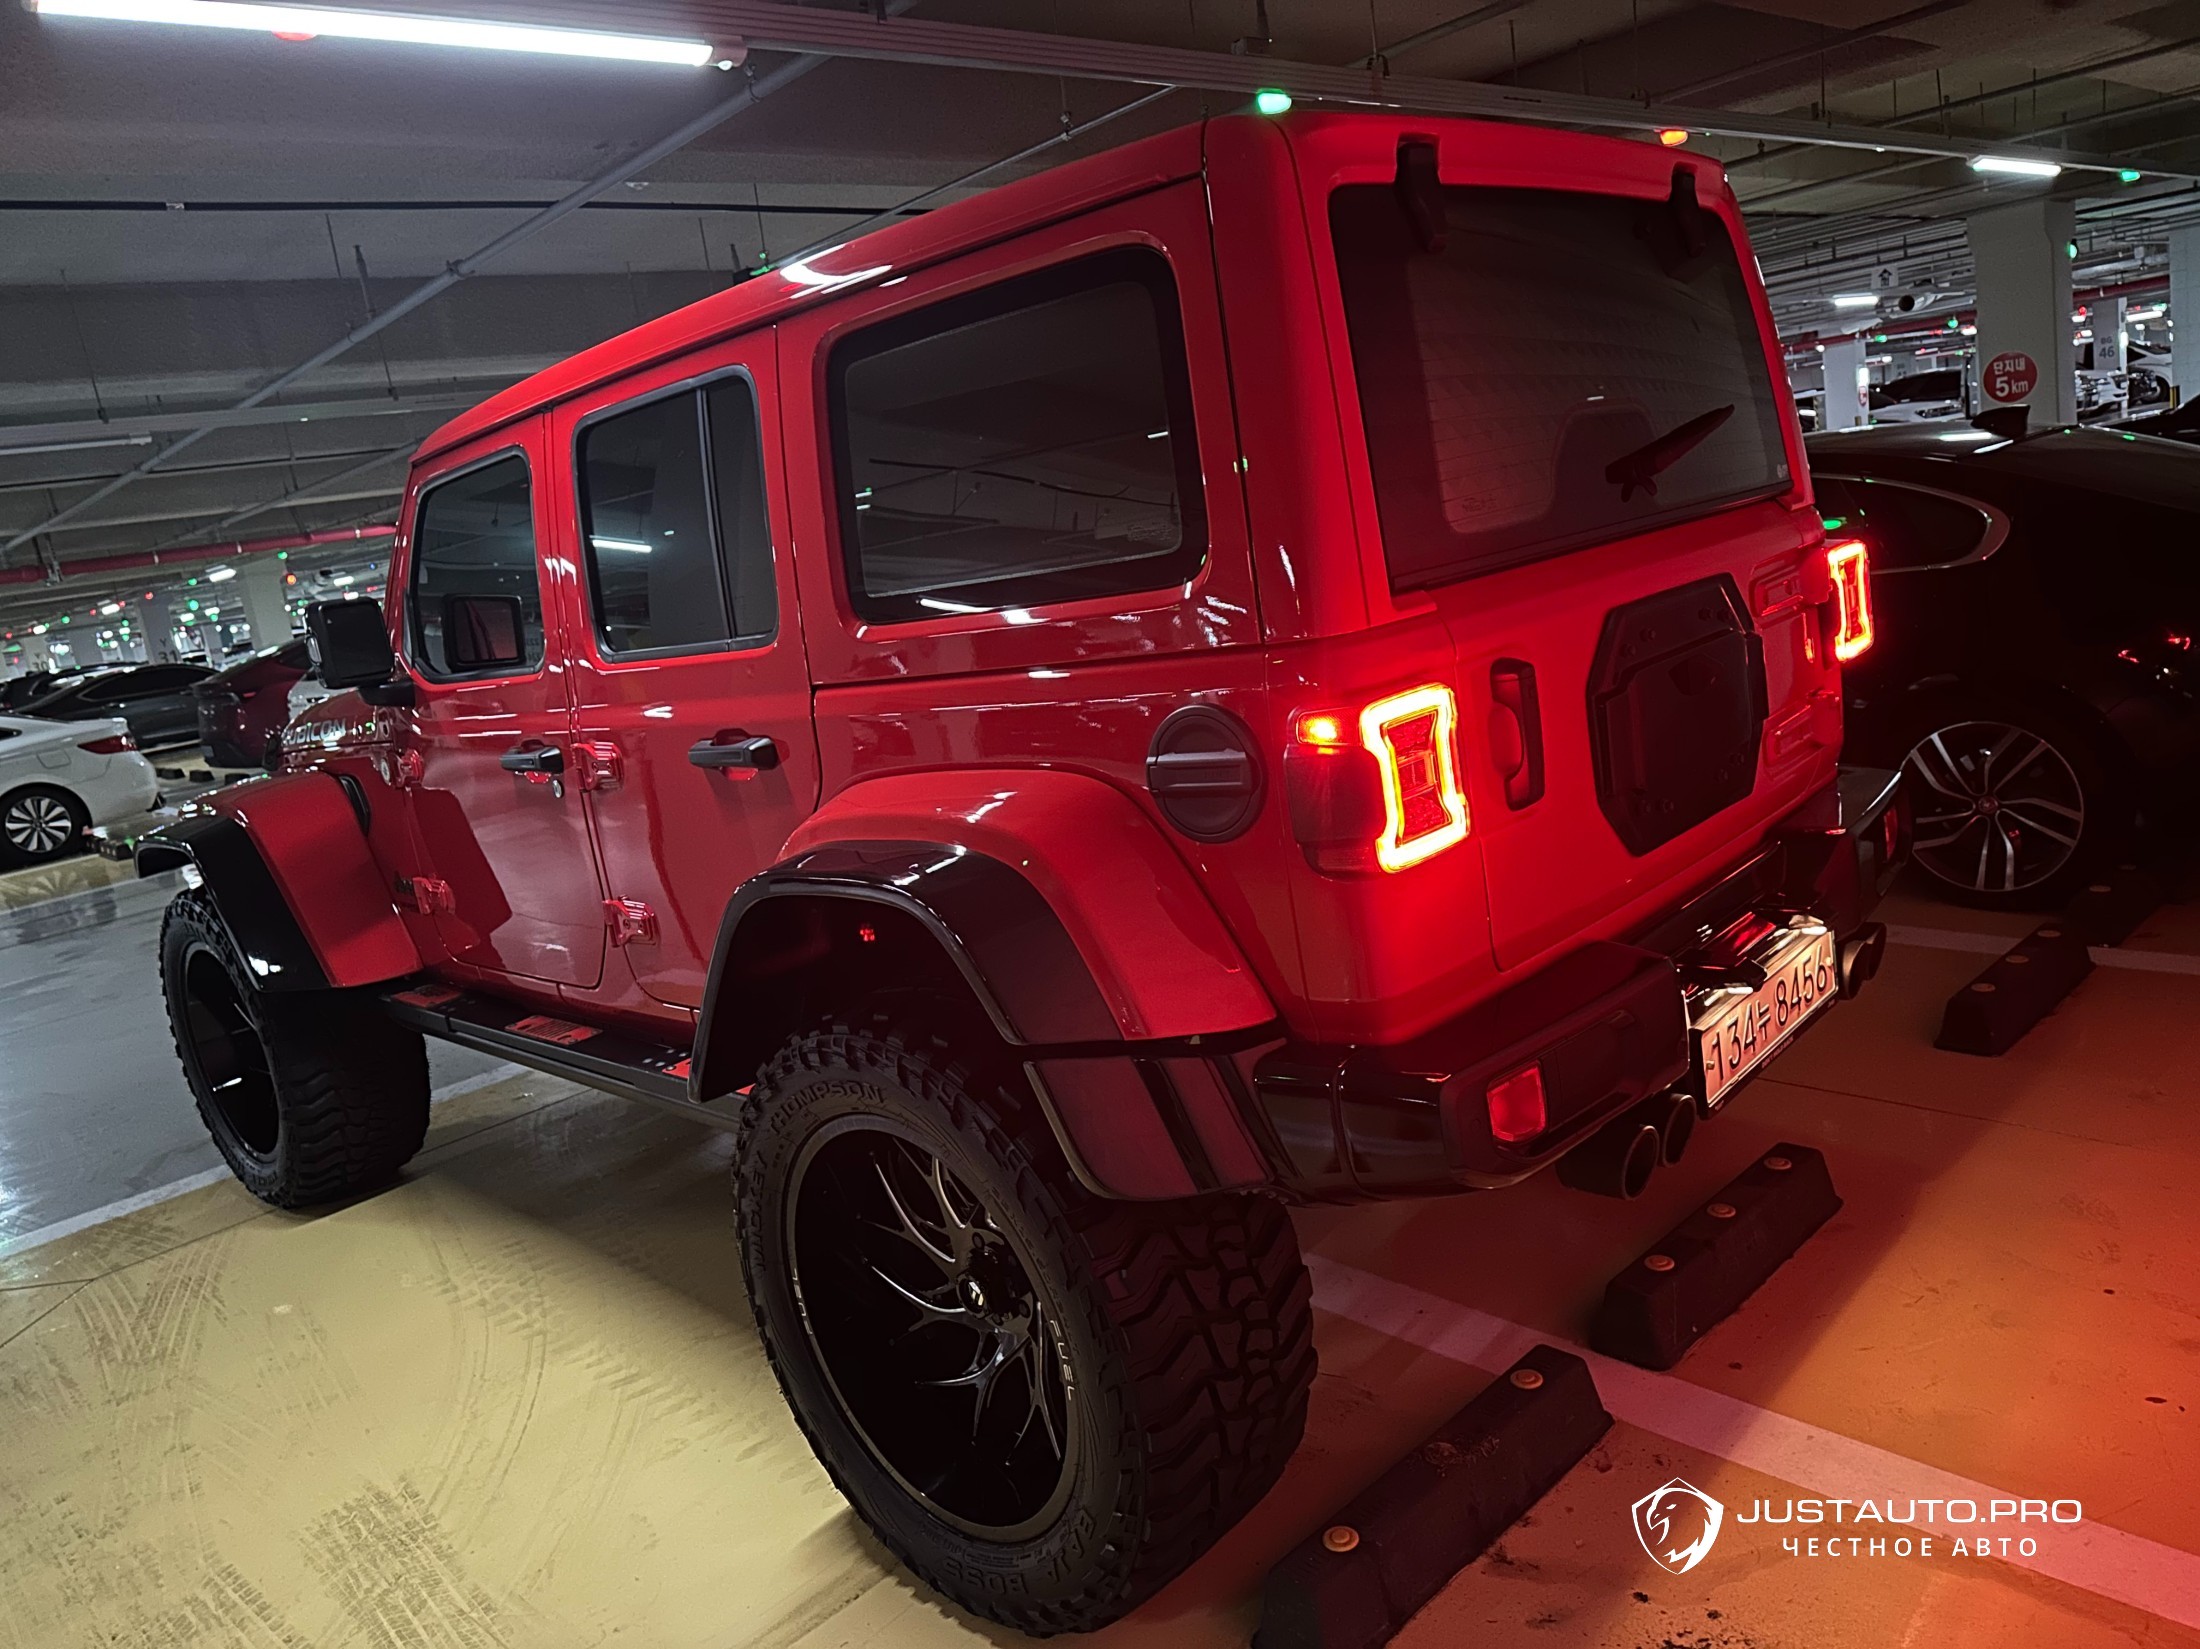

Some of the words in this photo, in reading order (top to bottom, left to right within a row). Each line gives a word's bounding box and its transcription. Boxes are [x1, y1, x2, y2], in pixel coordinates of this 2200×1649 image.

[1993, 357, 2026, 375] 단지내
[2099, 346, 2115, 359] 46
[158, 650, 178, 664] 31
[1774, 944, 1827, 1028] 8456
[769, 1079, 886, 1136] THOMPSON
[1050, 1319, 1076, 1402] FUEL
